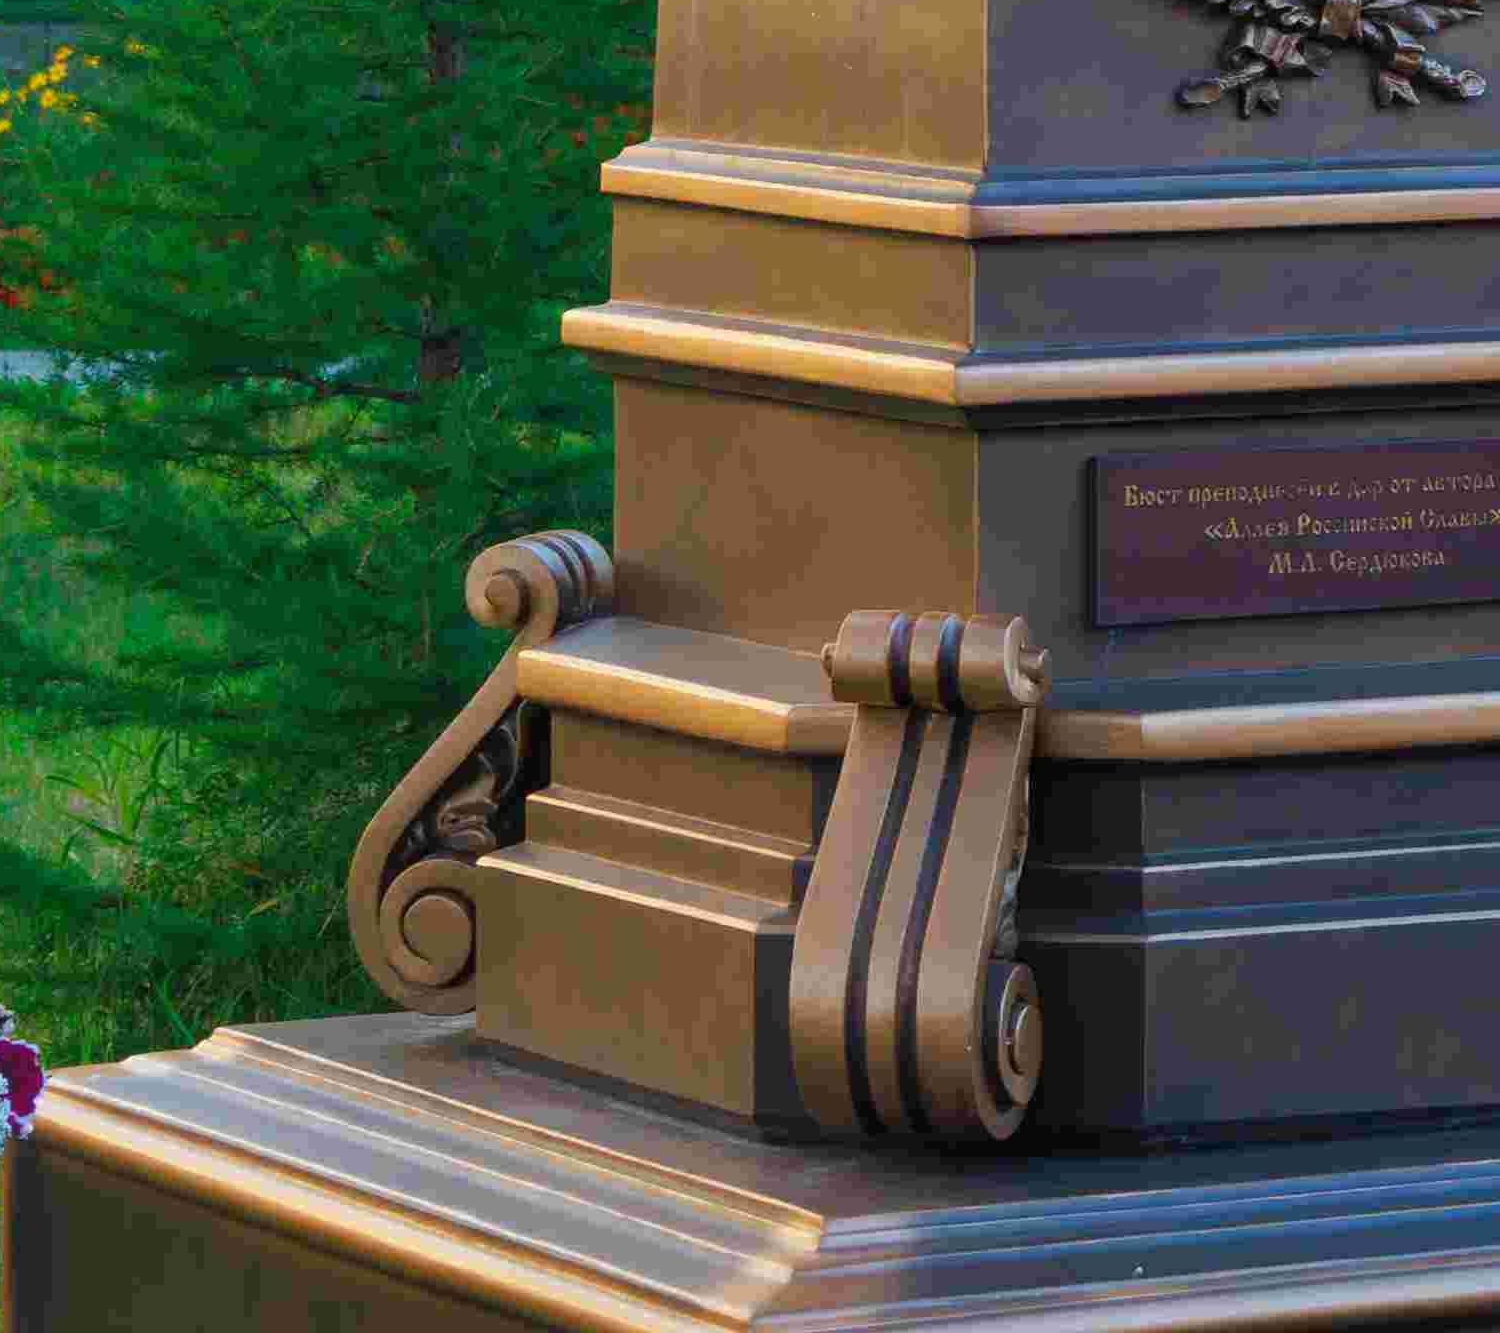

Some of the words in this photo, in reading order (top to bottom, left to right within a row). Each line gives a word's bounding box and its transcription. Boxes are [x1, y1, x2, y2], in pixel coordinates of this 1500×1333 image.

[1123, 484, 1182, 507] Бюст
[1389, 477, 1417, 494] от
[1421, 471, 1496, 494] автора
